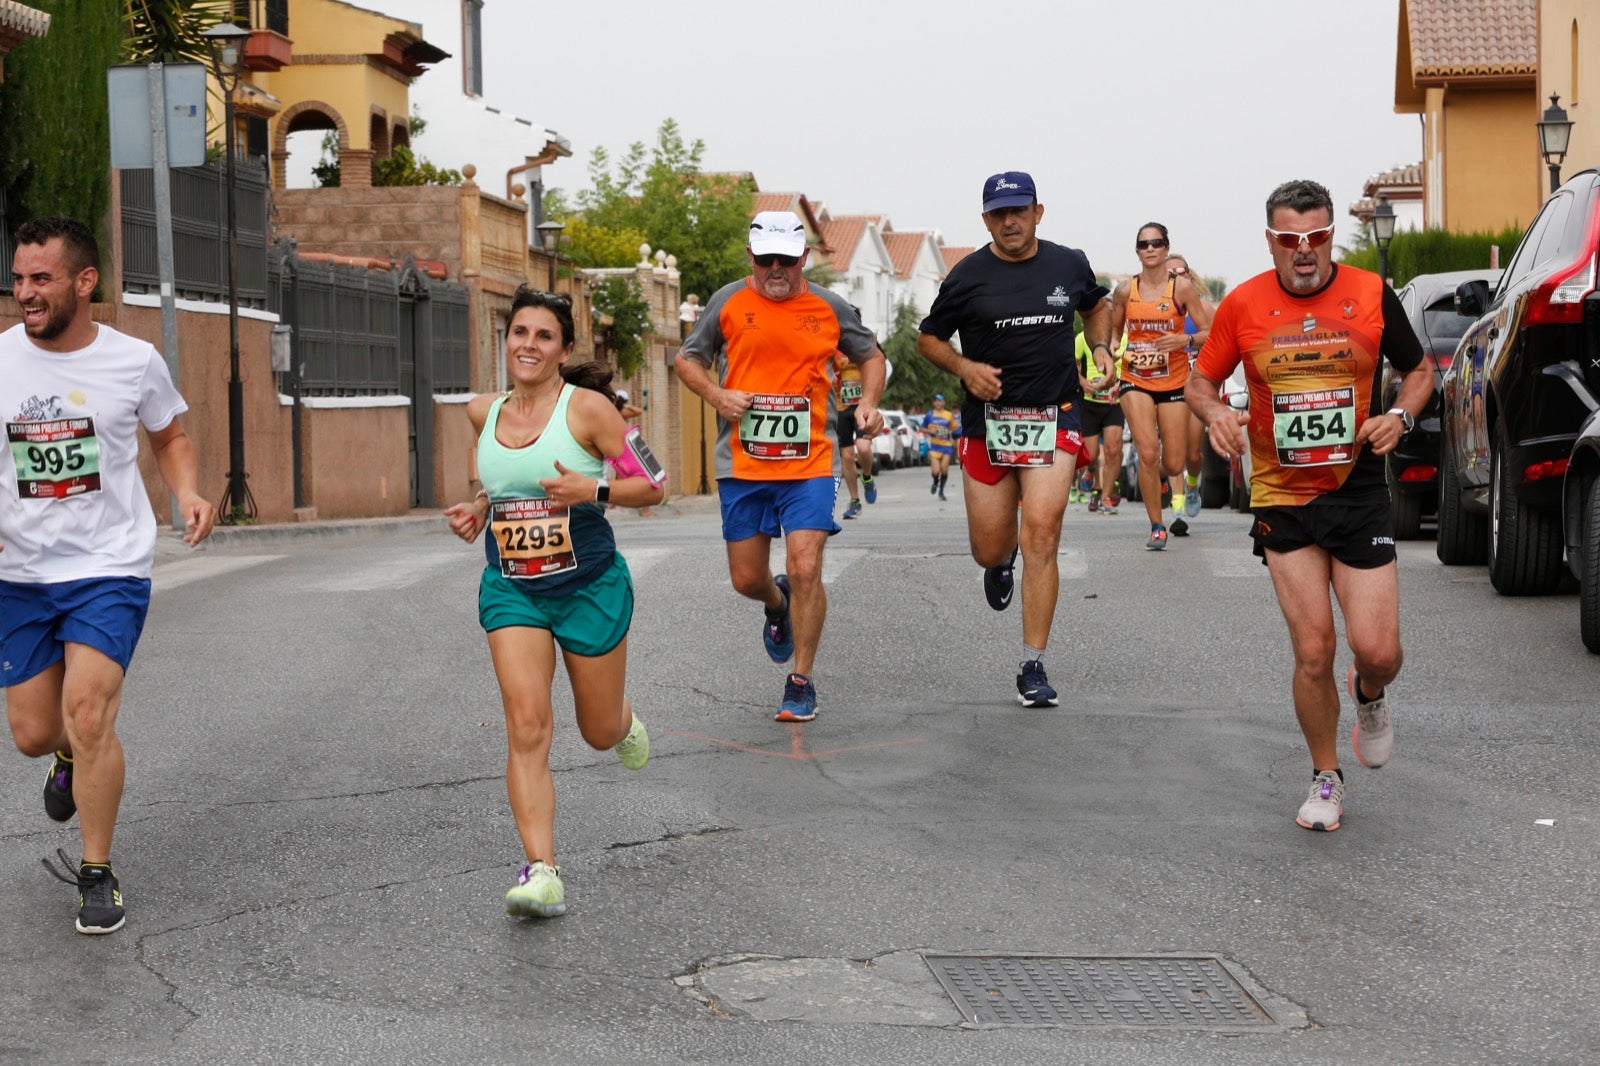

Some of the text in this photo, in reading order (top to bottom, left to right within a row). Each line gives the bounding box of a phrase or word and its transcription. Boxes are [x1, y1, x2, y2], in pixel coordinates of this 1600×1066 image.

[1130, 354, 1165, 366] 2279
[754, 396, 767, 404] GRAN
[767, 396, 785, 405] PREMIO
[1289, 394, 1304, 404] GRAN
[1304, 392, 1325, 403] PREMIO
[1325, 391, 1332, 400] DE
[1333, 389, 1350, 400] FONDO
[24, 423, 41, 434] GRAN
[41, 421, 60, 433] PREMIO
[60, 420, 69, 431] DE
[69, 419, 89, 430] FONDO
[750, 414, 799, 438] 770
[997, 424, 1046, 447] 357
[1286, 411, 1347, 442] 454
[27, 443, 86, 475] 995
[504, 502, 516, 511] GRAN
[516, 500, 536, 511] PREMIO
[535, 499, 544, 510] DE
[501, 523, 565, 551] 2295
